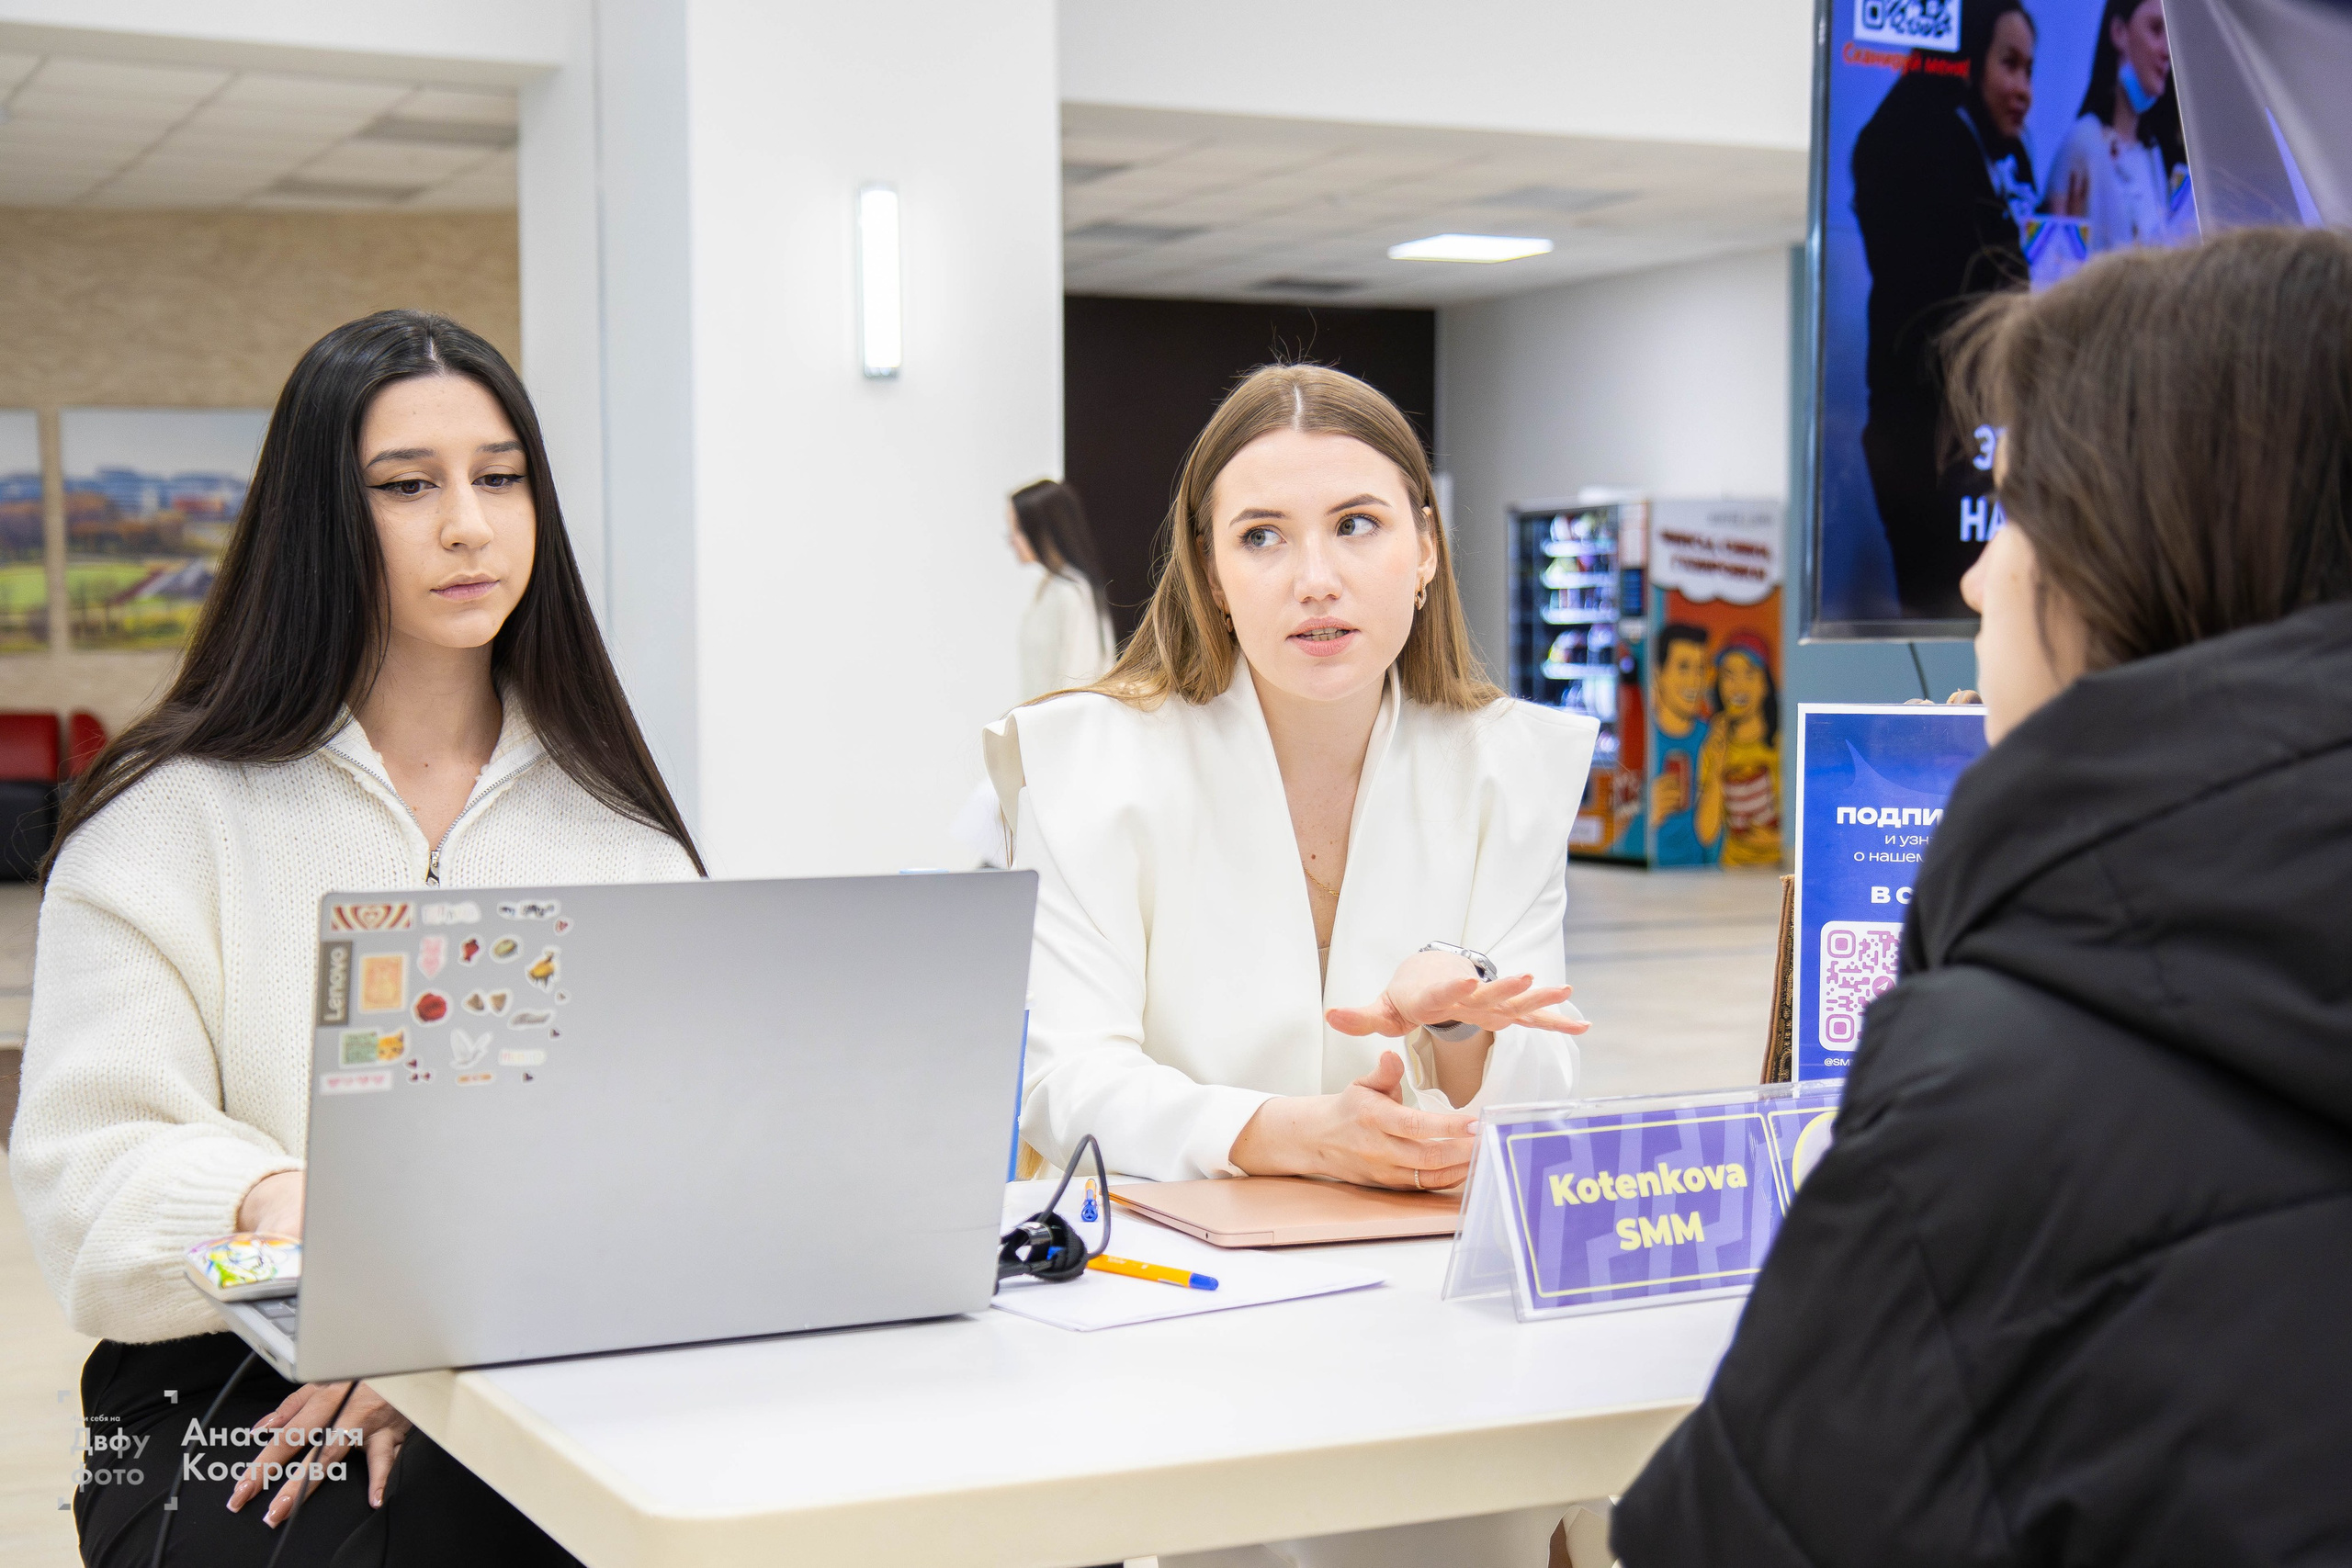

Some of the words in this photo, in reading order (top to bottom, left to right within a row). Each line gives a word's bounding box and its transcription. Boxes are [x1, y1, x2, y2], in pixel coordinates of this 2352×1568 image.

[1884, 834, 1896, 845] и
[1898, 835, 1933, 847] узн
[1853, 852, 1865, 862] о
[1871, 886, 1891, 904] В
[323, 946, 347, 1021] Lenovo
[1548, 1162, 1748, 1207] Kotenkova
[1615, 1211, 1705, 1251] SMM
